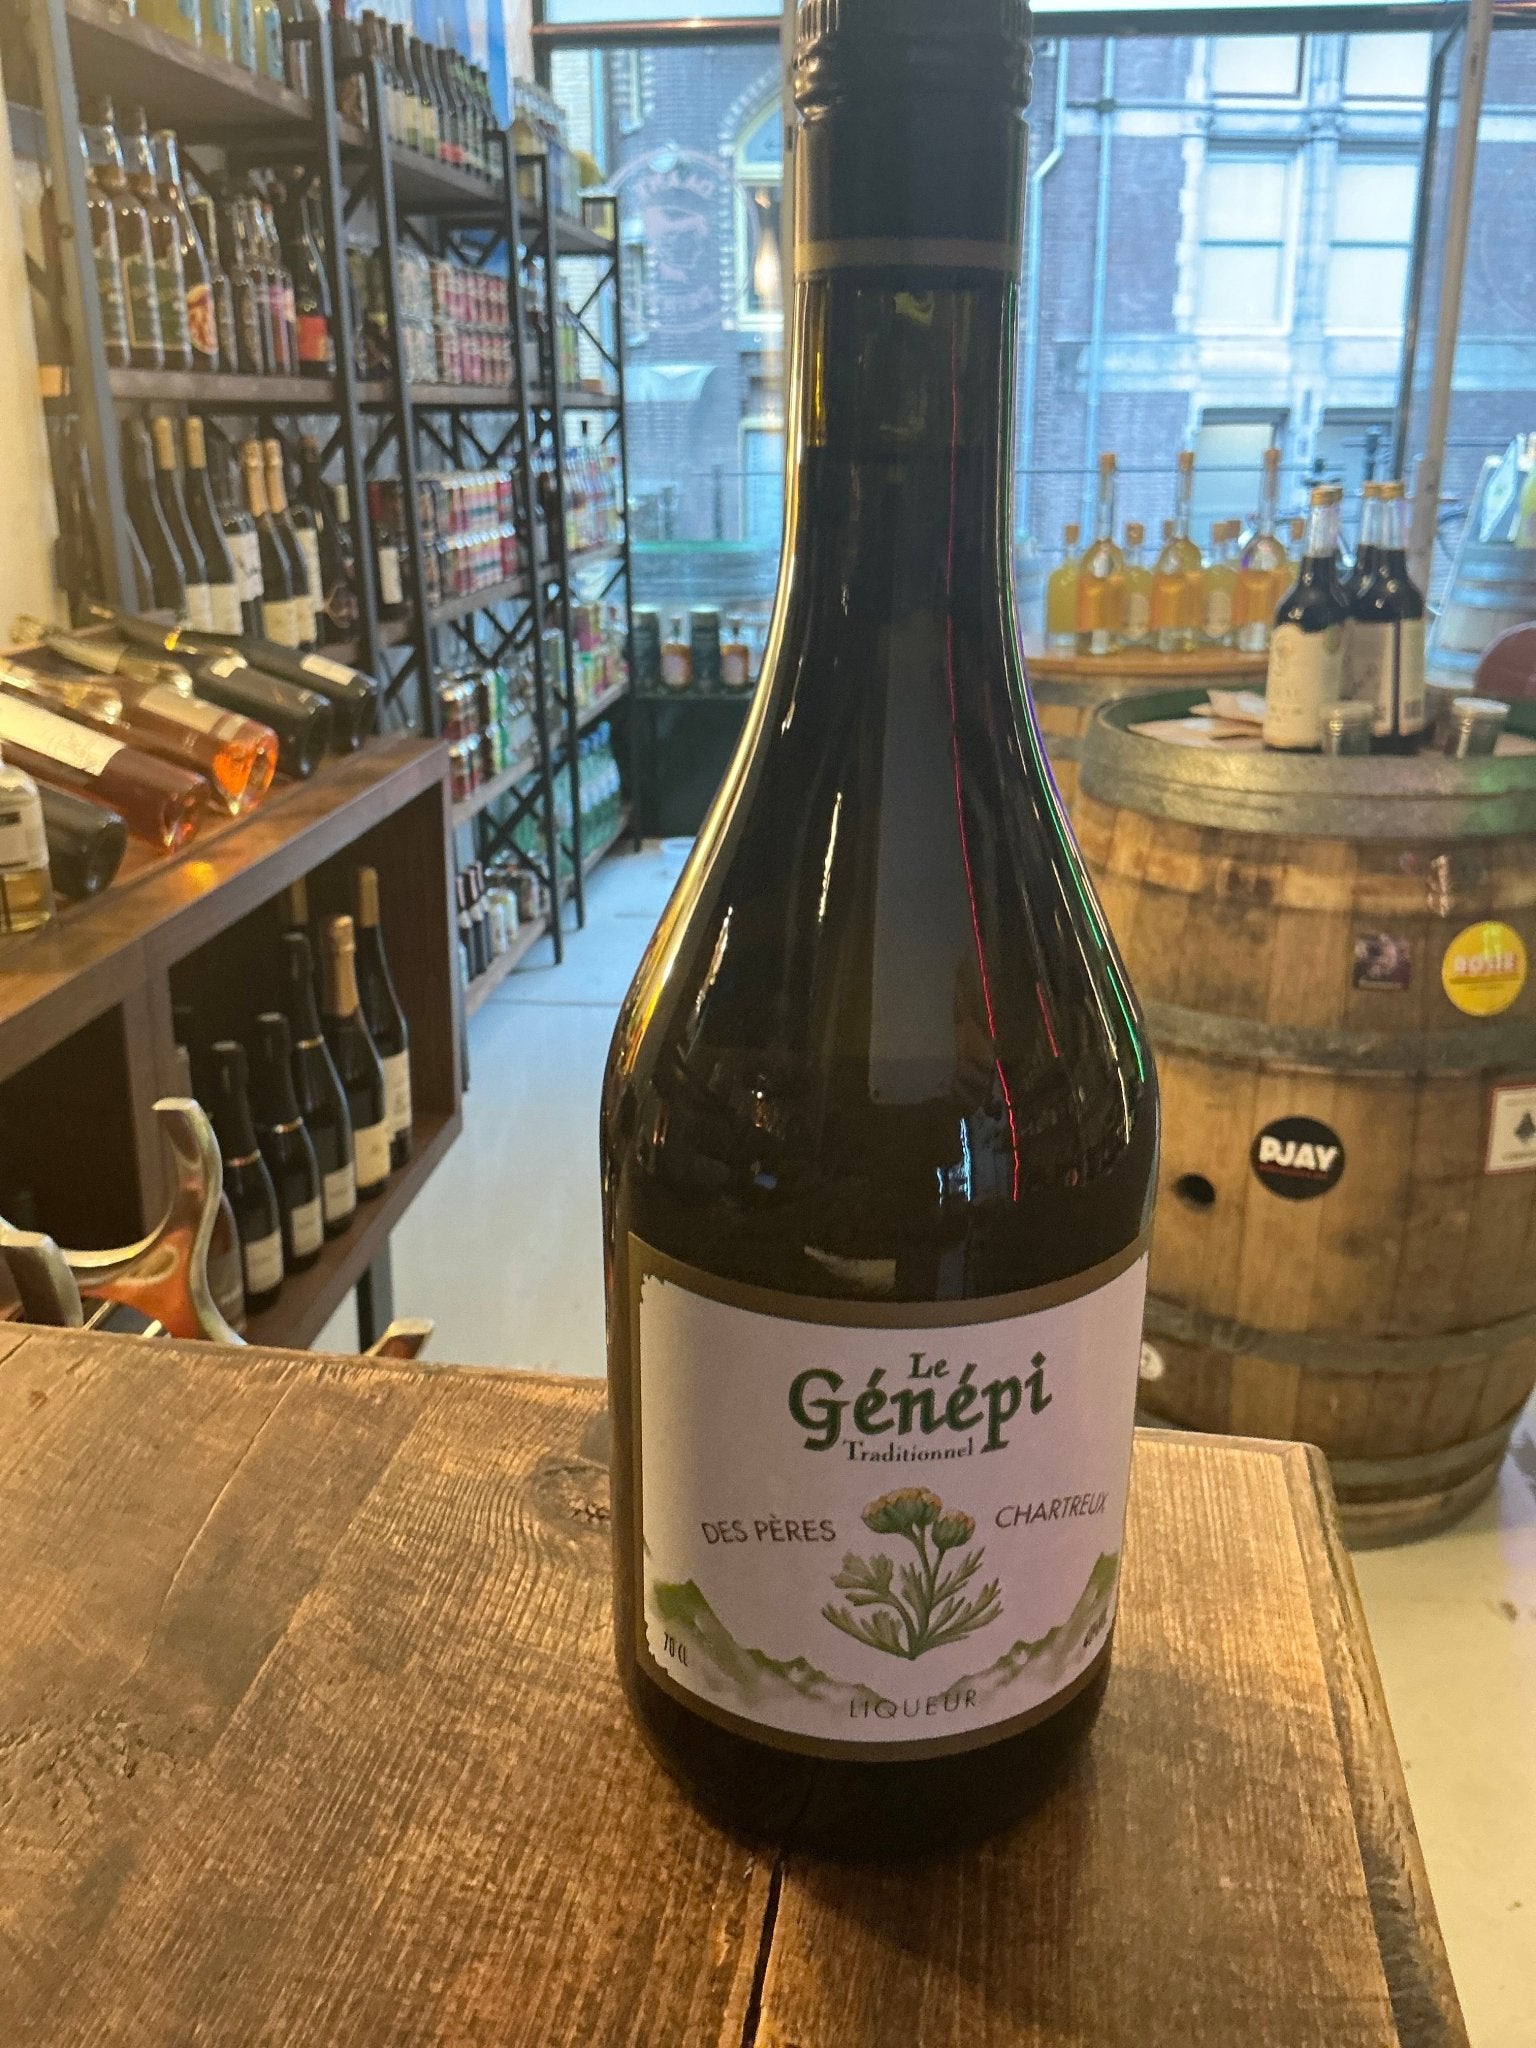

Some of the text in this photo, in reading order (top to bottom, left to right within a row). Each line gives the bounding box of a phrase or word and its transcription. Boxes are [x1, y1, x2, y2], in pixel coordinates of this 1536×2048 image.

[907, 1352, 951, 1379] Le
[787, 1351, 1053, 1454] Génépi
[842, 1437, 974, 1463] Traditionnel
[701, 1491, 1109, 1544] DES PÈRES CHARTREUX
[663, 1631, 675, 1658] 70
[850, 1689, 977, 1719] LIQUEUR
